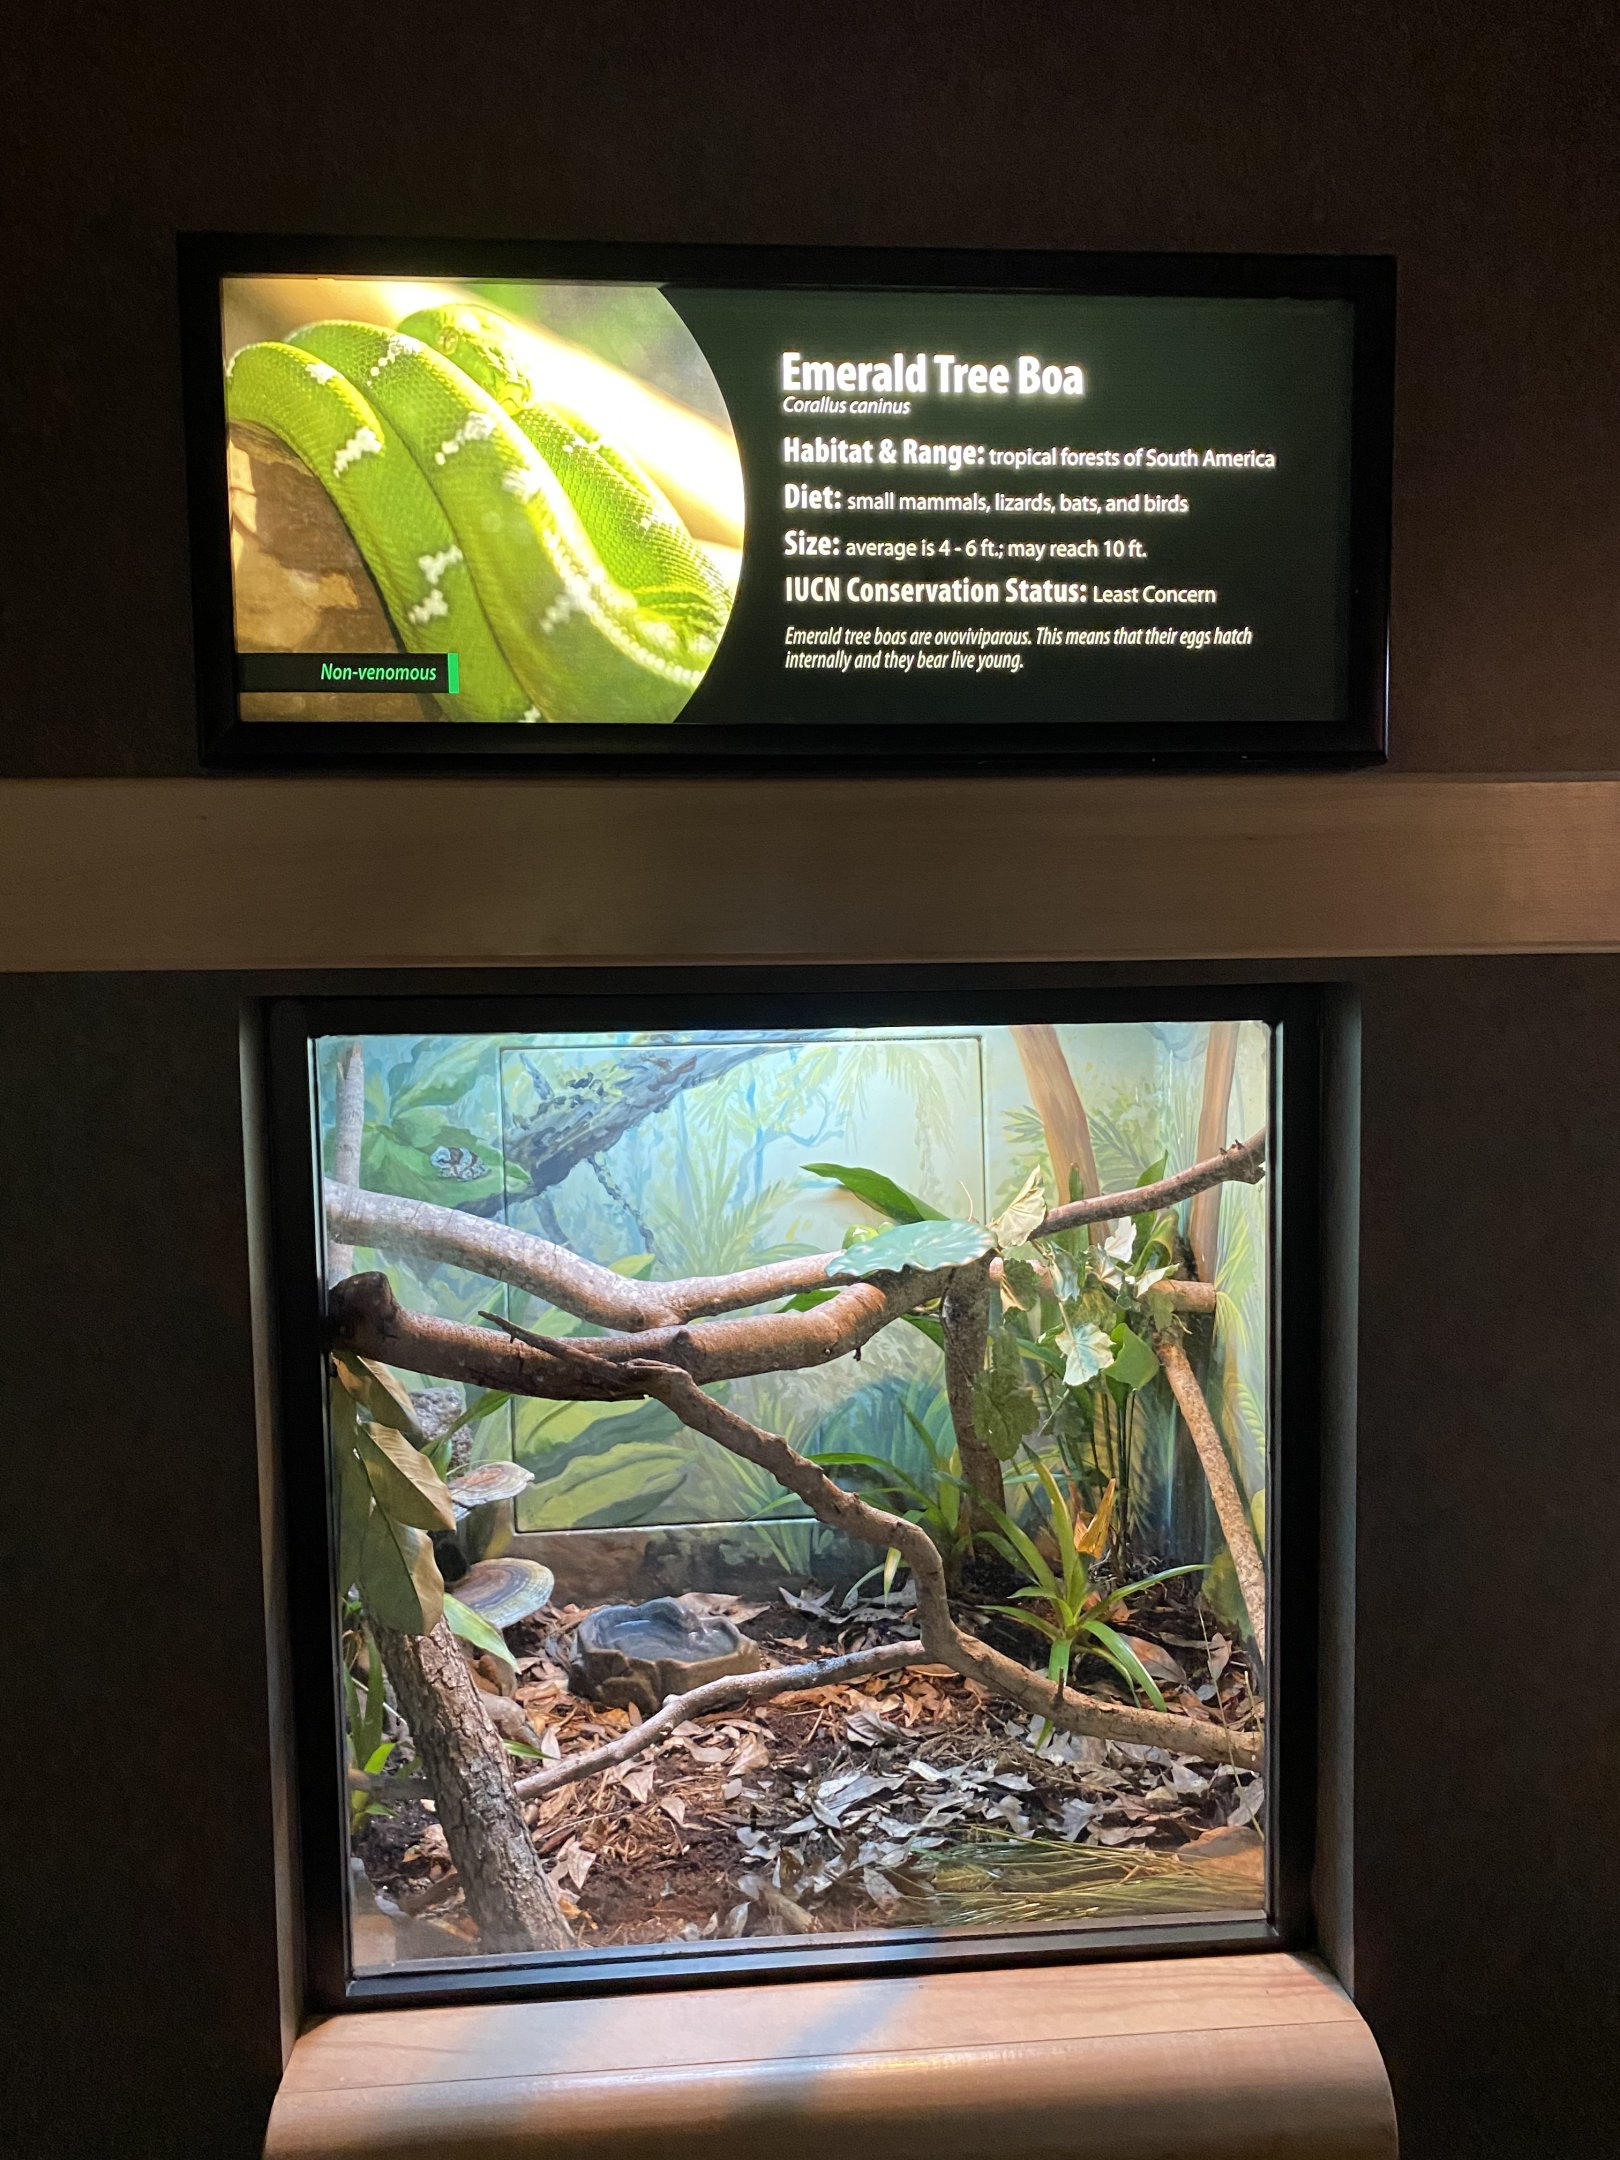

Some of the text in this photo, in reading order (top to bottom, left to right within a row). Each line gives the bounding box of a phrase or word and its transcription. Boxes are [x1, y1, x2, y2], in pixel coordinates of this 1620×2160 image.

[783, 352, 1083, 395] Emerald Tree Boa
[783, 396, 910, 414] Corallus caninus
[784, 437, 1275, 472] Habitat & Range: tropical forests of South America
[785, 483, 1189, 514] Diet: small mammals, lizards, bats, and birds
[785, 530, 840, 555] Size:
[846, 543, 917, 560] average
[922, 539, 935, 556] is
[939, 540, 950, 556] 4
[965, 540, 977, 557] 6
[981, 539, 1004, 559] ft.;
[1008, 544, 1046, 561] may
[1050, 540, 1098, 557] reach
[1104, 540, 1125, 557] 10
[1128, 539, 1147, 557] ft.
[786, 577, 1216, 603] IUCN Conservation Status: Least Concern
[785, 627, 1252, 649] Emerald tree boas are ovoviviparous. This means that their eggs hatch
[320, 663, 437, 681] Non-venomous
[786, 650, 1023, 672] internally and they bear live young.
